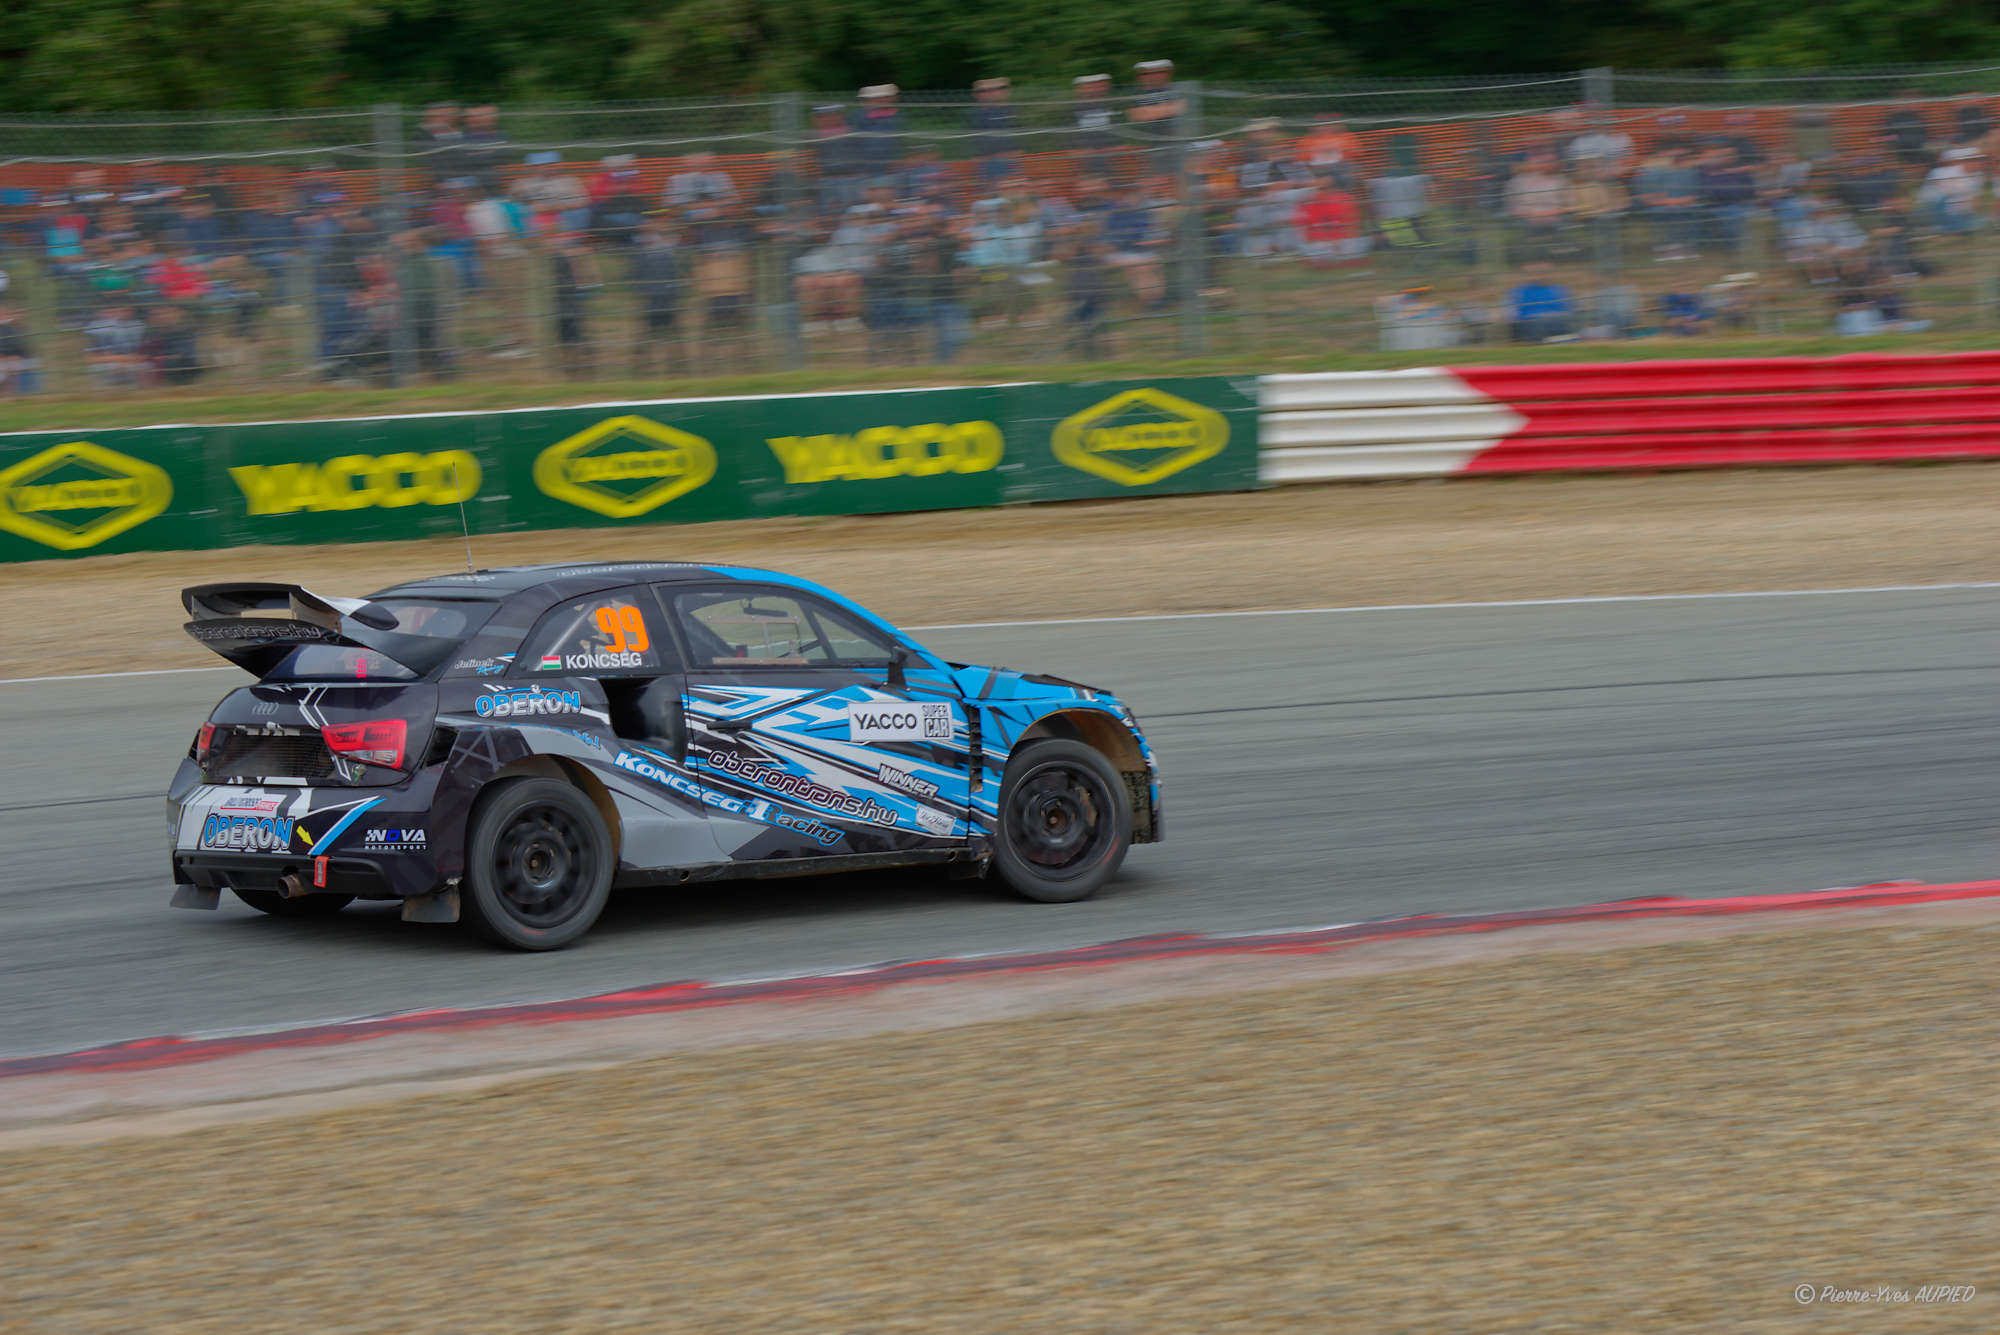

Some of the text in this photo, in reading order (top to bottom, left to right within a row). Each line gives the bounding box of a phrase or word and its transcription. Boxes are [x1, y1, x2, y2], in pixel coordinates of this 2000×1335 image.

[766, 420, 1004, 484] YACCO
[228, 449, 482, 515] YACCO
[595, 606, 649, 653] 99
[566, 652, 642, 669] KONCSEG
[475, 691, 581, 717] OBERON
[922, 704, 949, 717] SUPER
[854, 713, 917, 729] YACCO
[925, 718, 949, 737] CAR
[708, 750, 898, 826] oberontrans.hu
[878, 763, 939, 800] WINNER
[203, 814, 295, 851] OBERON
[365, 829, 426, 841] NOVA
